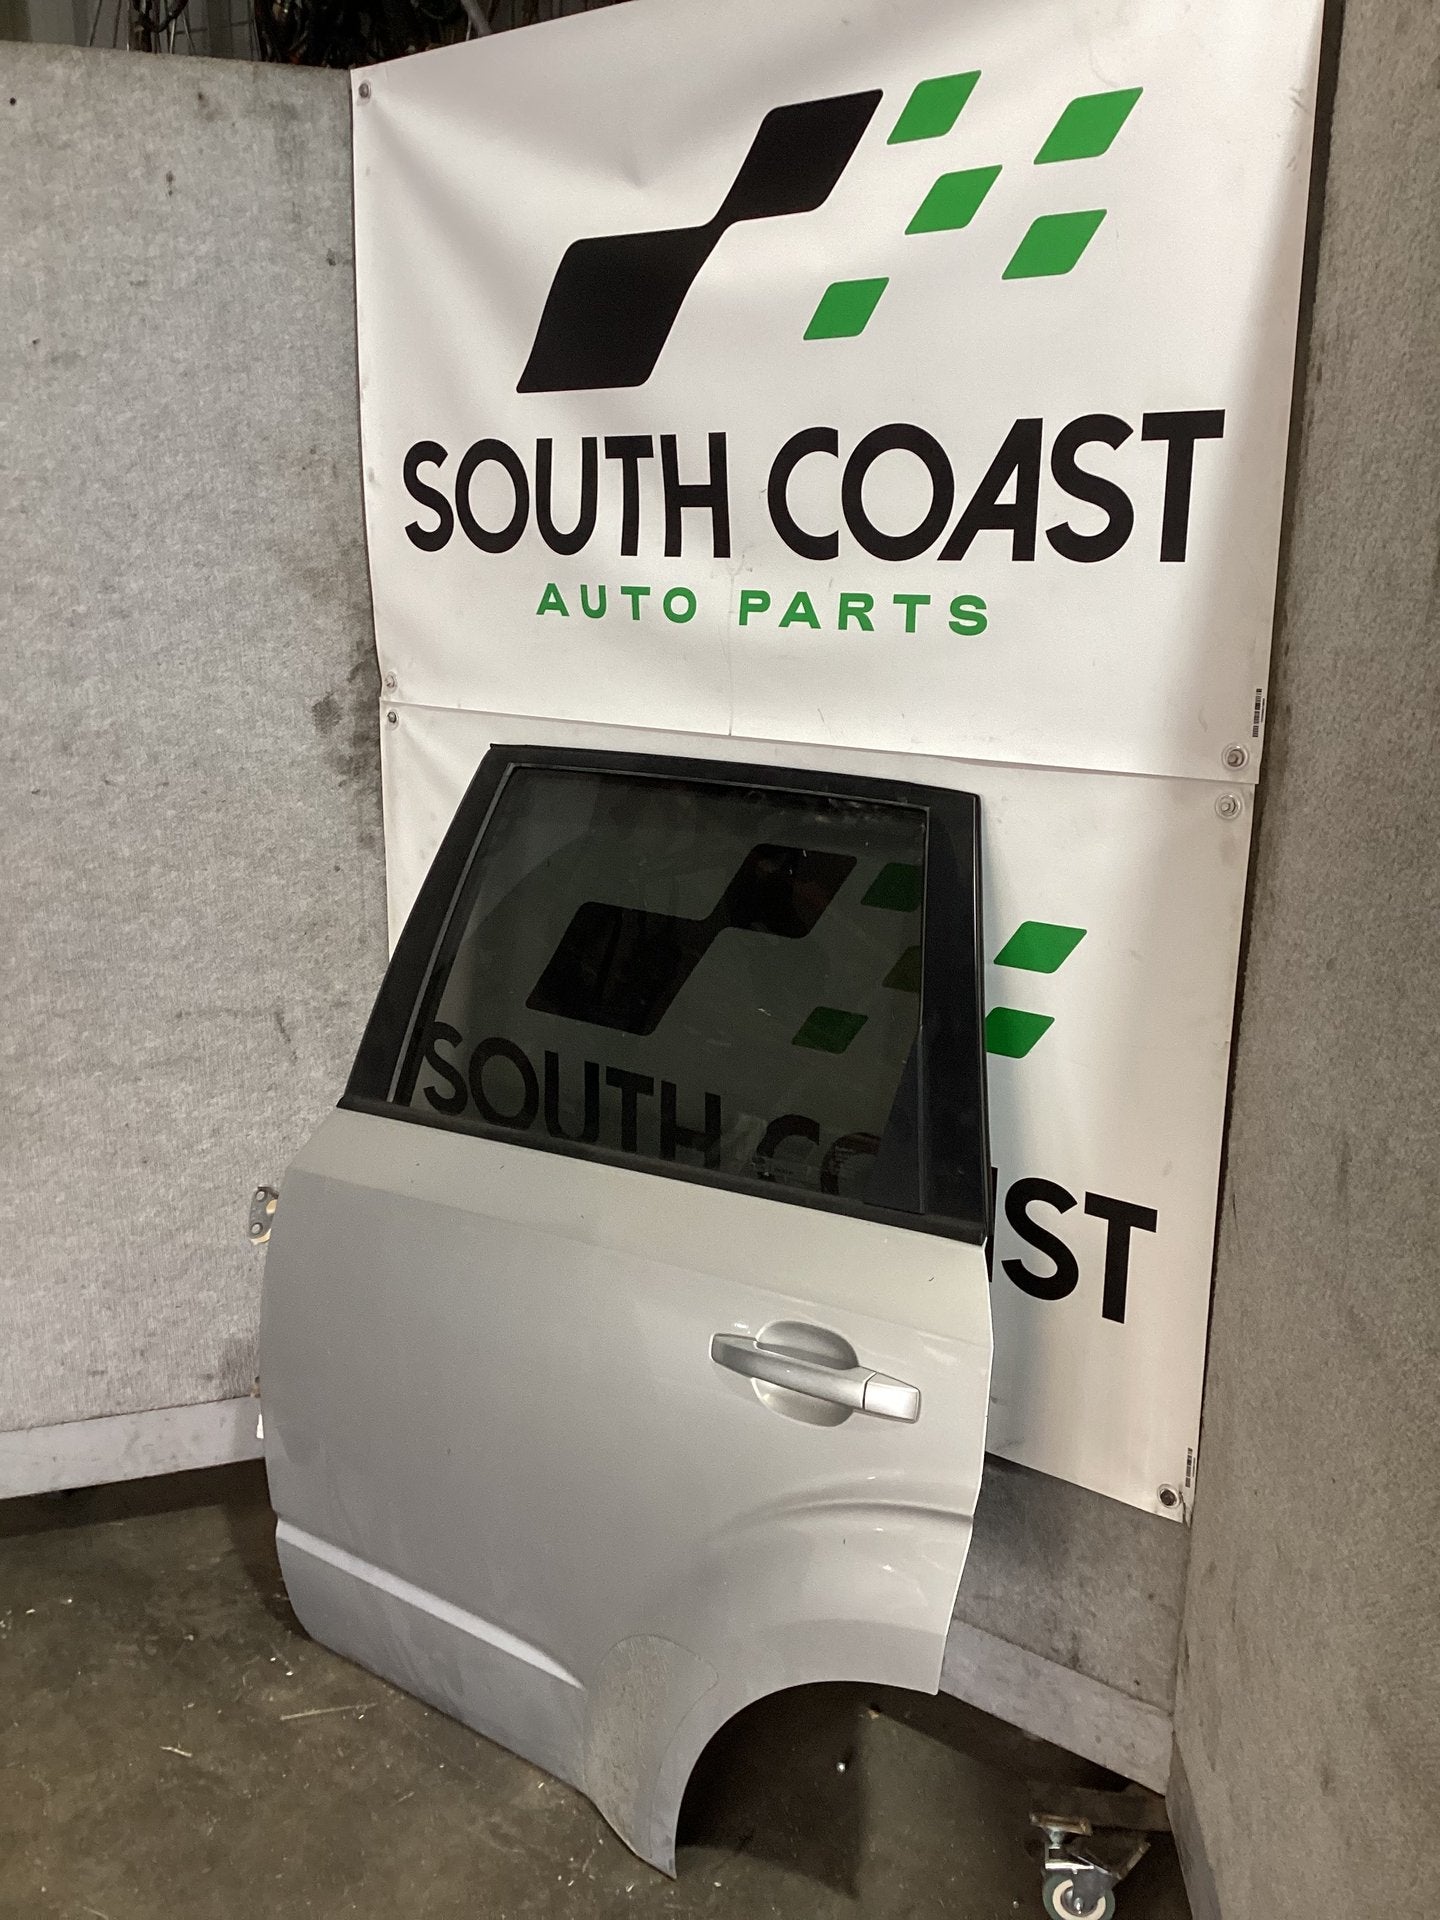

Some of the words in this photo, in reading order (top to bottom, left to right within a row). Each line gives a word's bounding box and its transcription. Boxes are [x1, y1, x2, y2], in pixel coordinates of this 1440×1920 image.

[404, 432, 730, 558] SOUTH
[768, 410, 1225, 562] COAST
[537, 583, 697, 624] AUTO
[740, 590, 988, 636] PARTS
[422, 1020, 722, 1170] SOUTH
